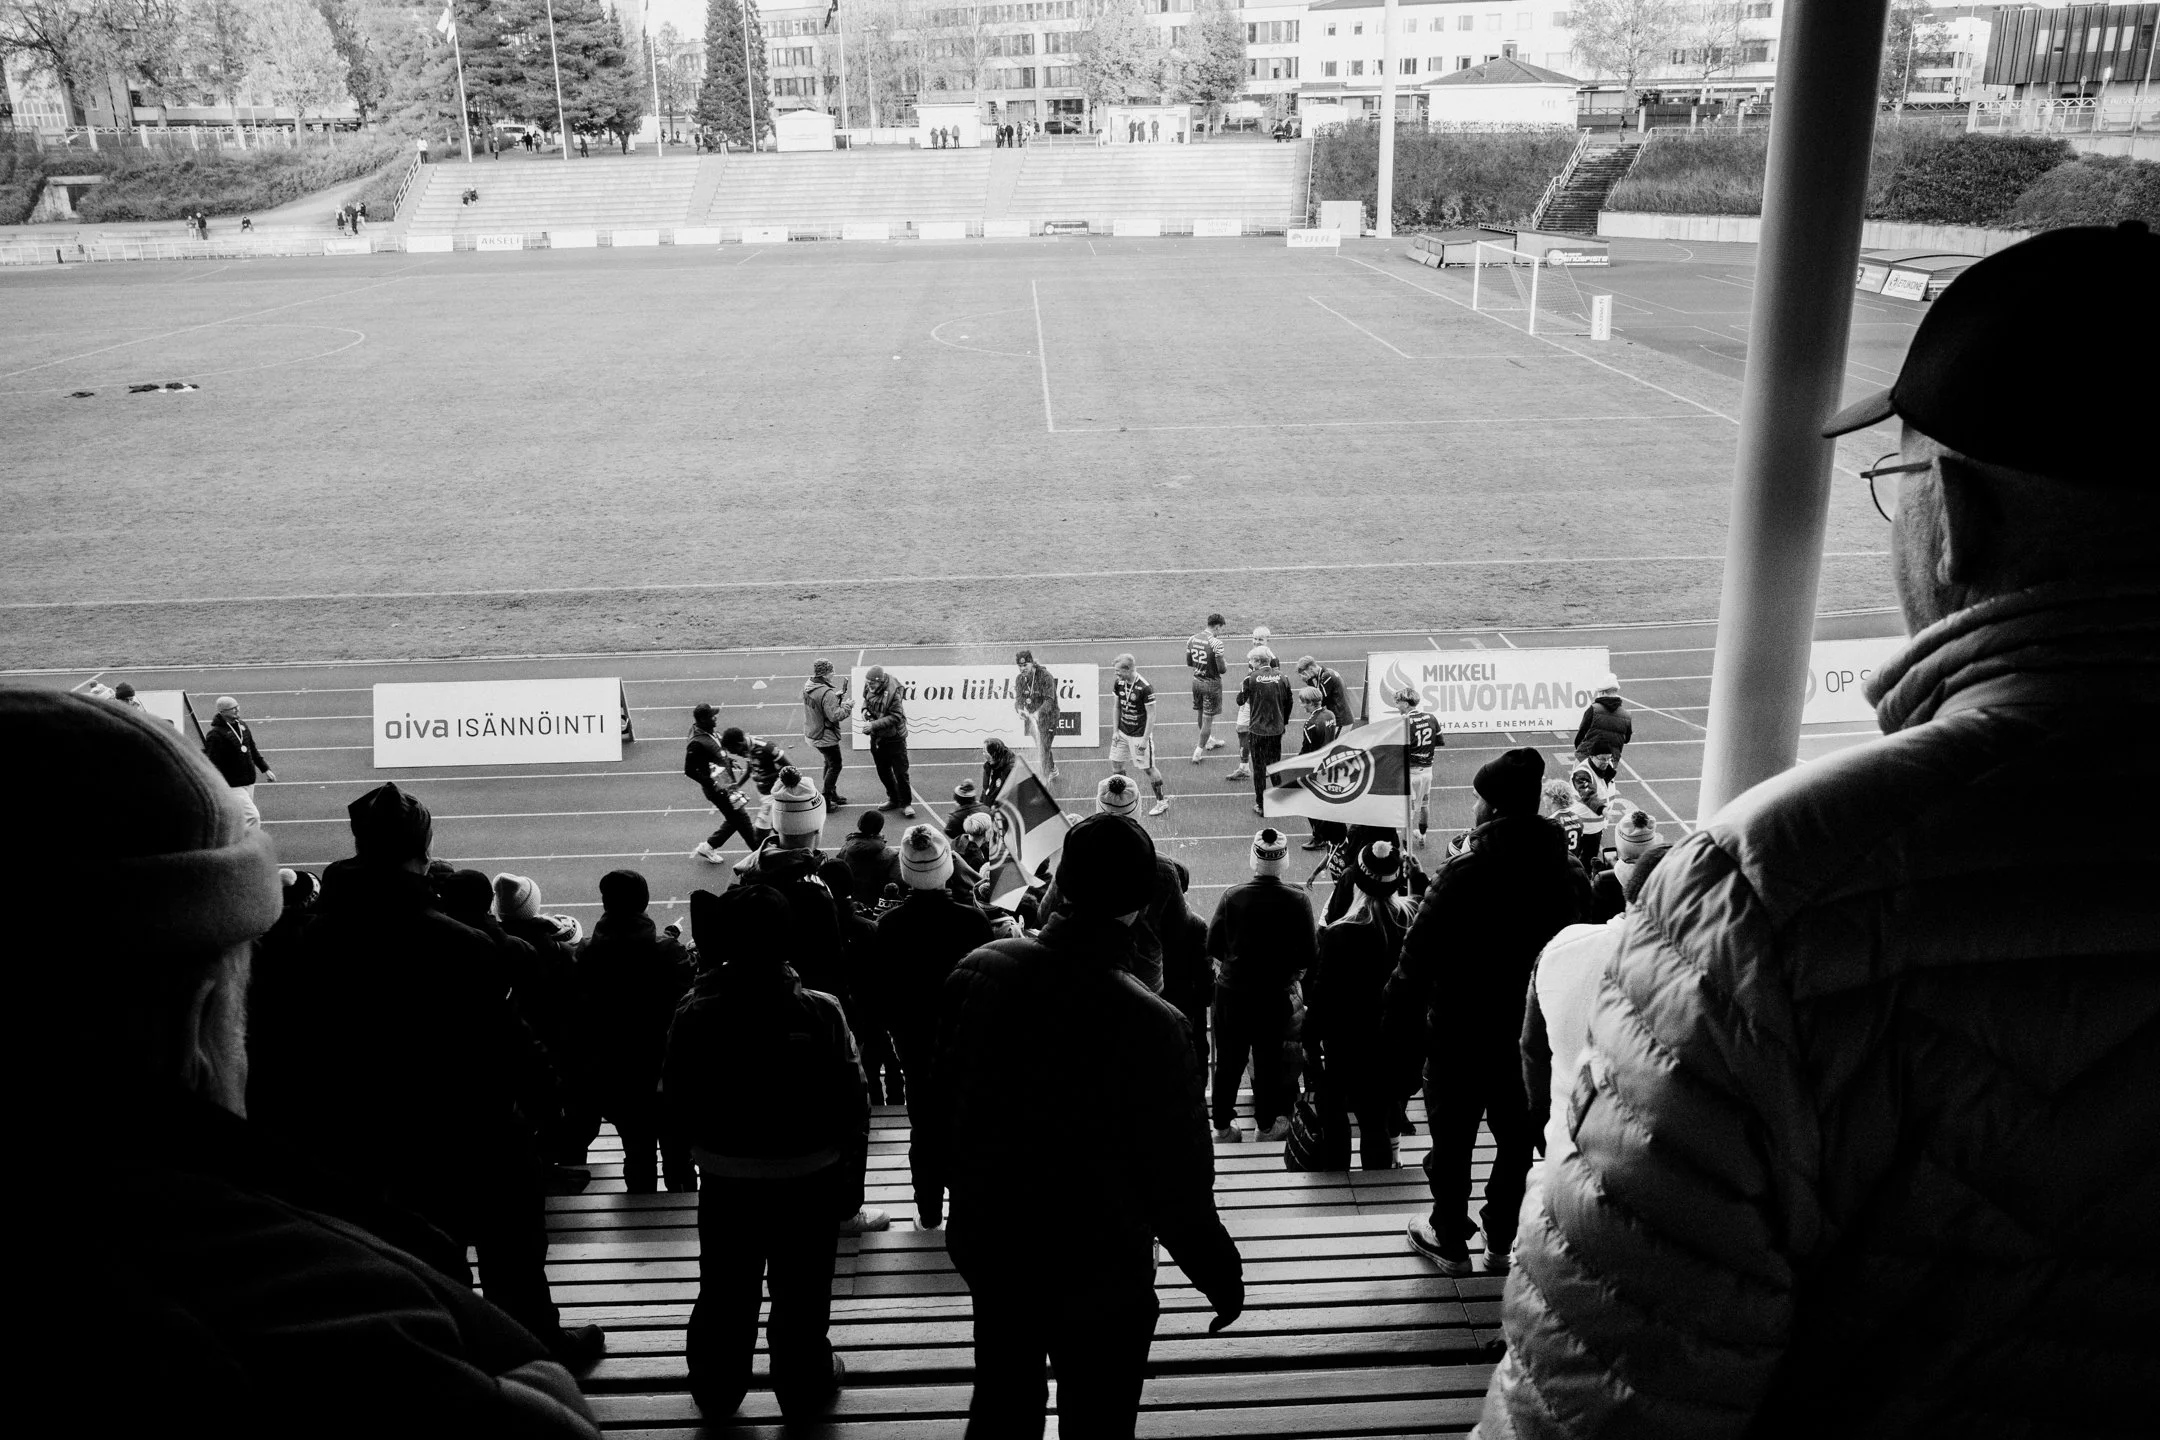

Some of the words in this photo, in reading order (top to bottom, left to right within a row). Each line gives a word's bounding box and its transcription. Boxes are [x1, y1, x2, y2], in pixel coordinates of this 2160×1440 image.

[1190, 648, 1208, 665] 22
[1422, 663, 1496, 682] MIKKELI
[1825, 670, 1855, 693] OP
[923, 685, 954, 701] on
[1421, 681, 1573, 713] SIIVOTAAN
[385, 712, 449, 740] oiva
[457, 710, 605, 738] ISÄNNÖINTI
[1440, 721, 1489, 729] HTAASTI
[1496, 717, 1554, 728] ENEMMÄN
[1414, 727, 1433, 747] 12
